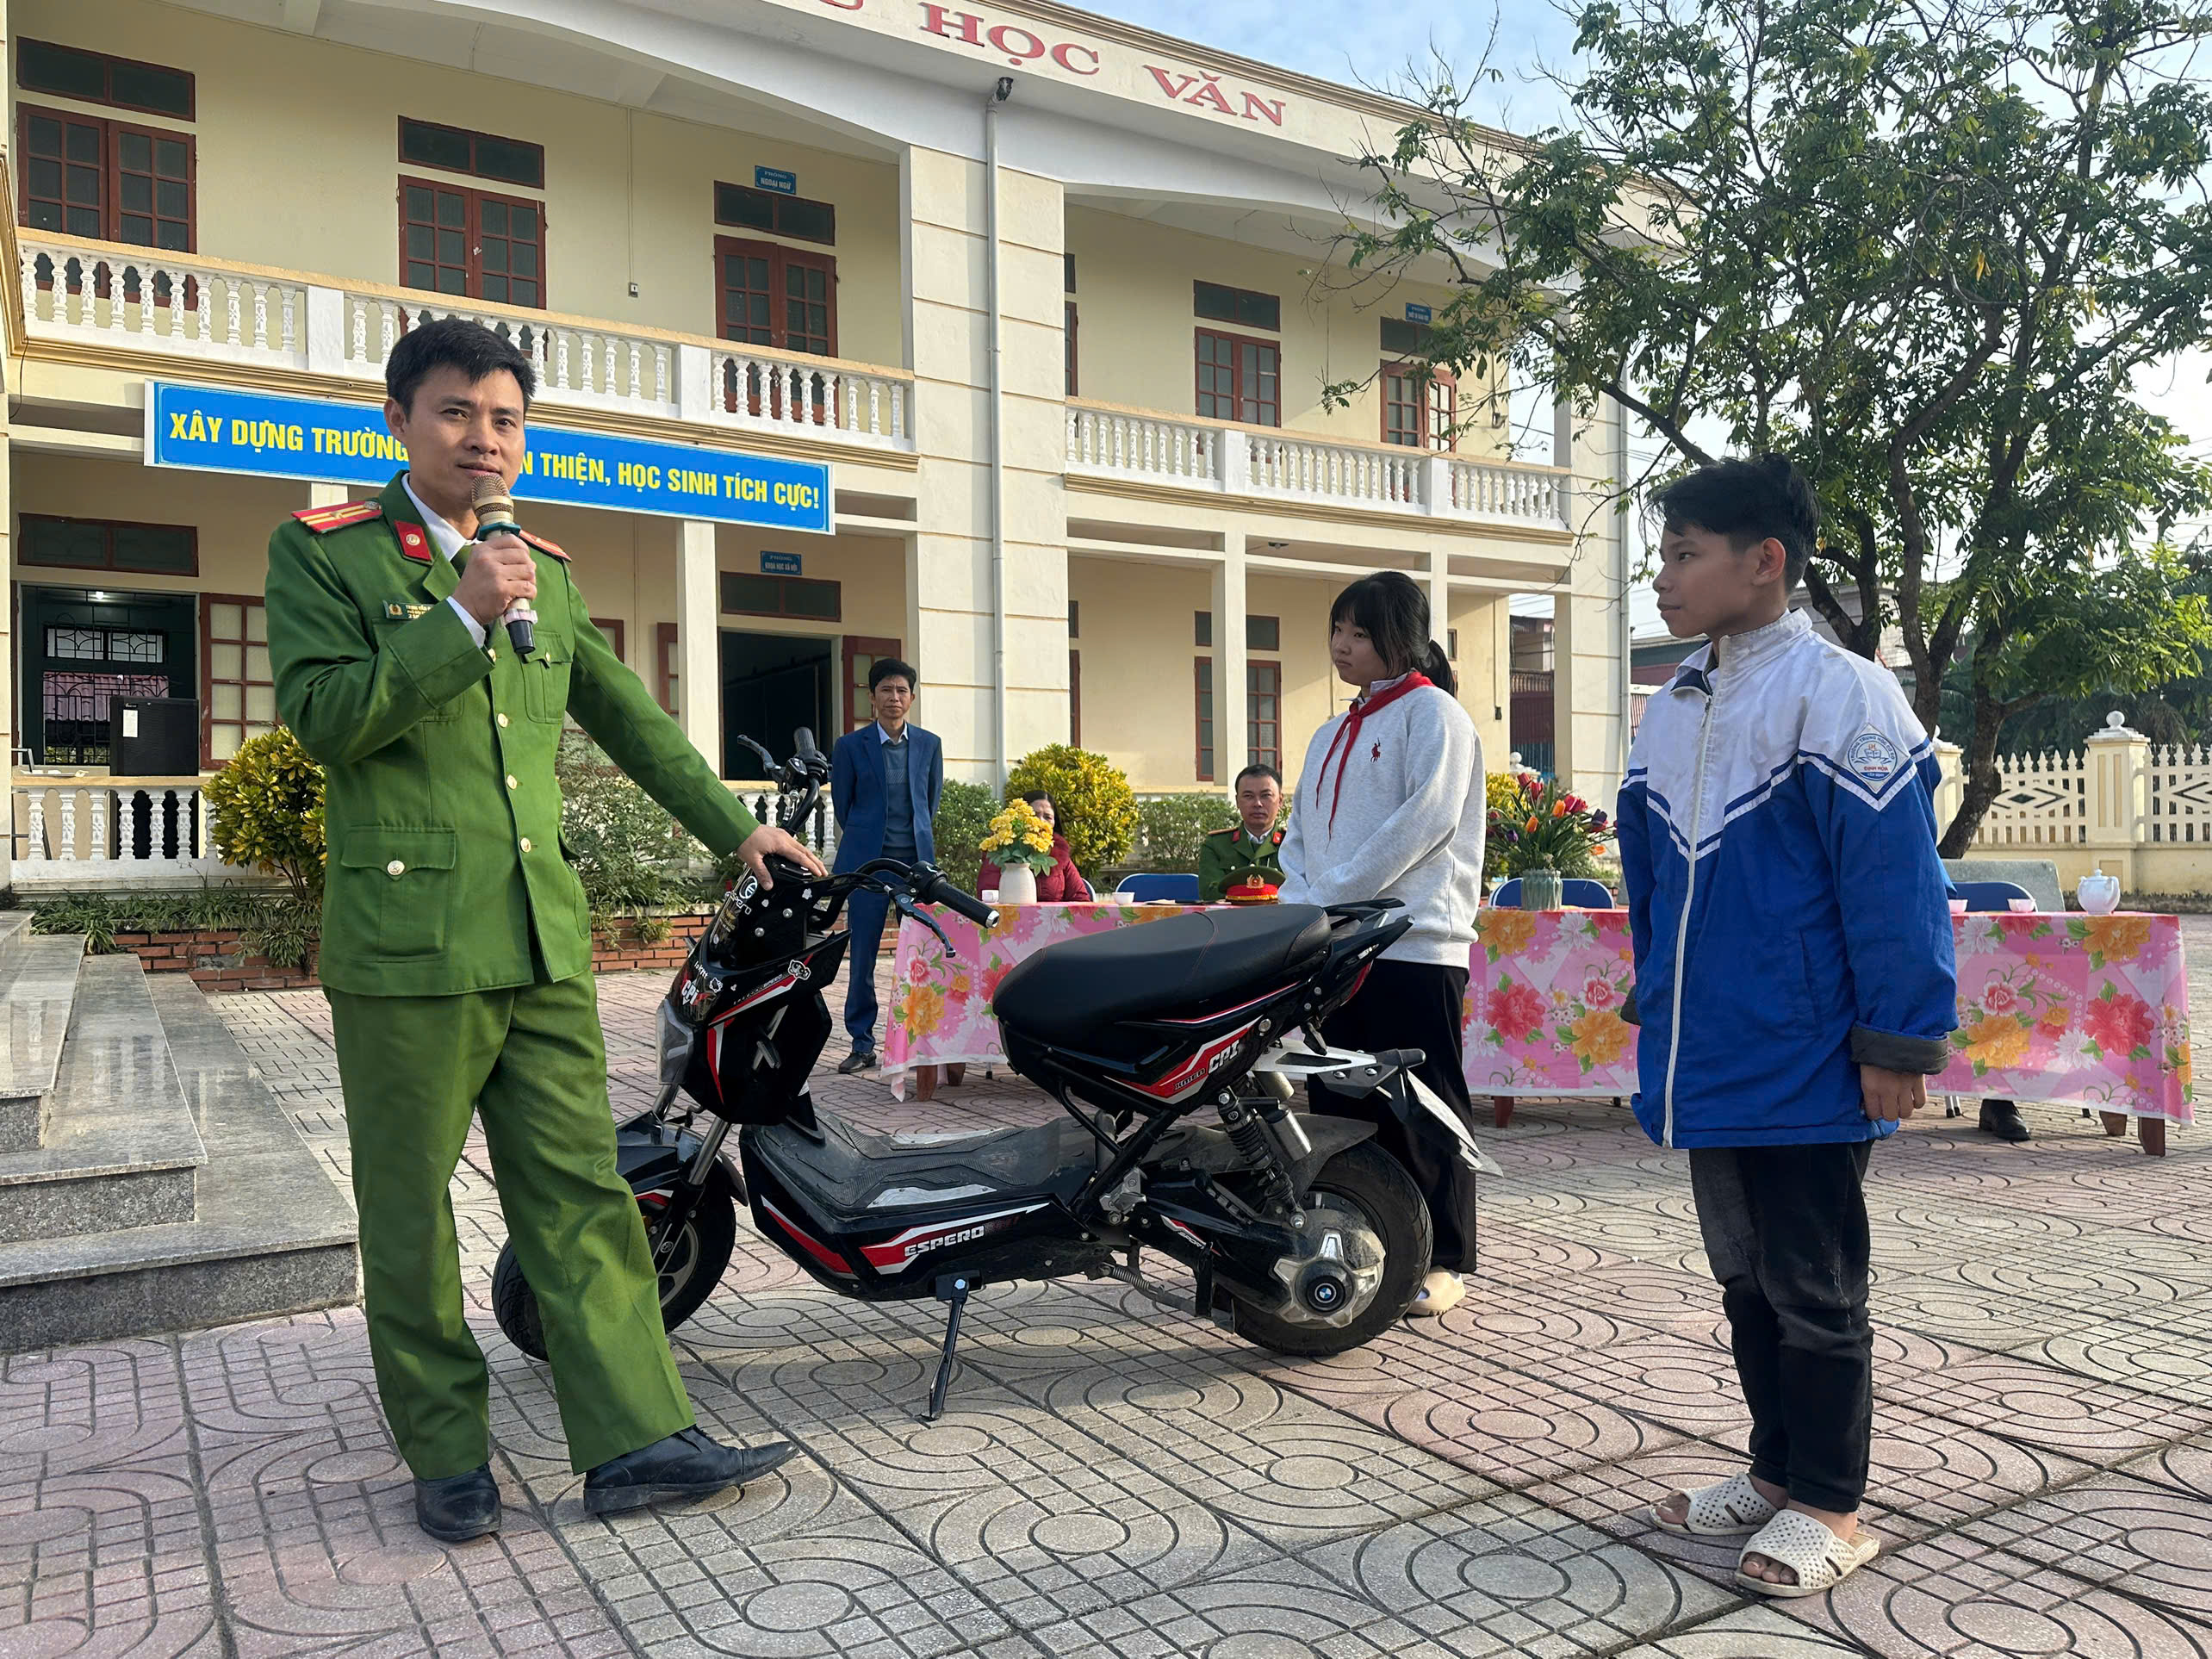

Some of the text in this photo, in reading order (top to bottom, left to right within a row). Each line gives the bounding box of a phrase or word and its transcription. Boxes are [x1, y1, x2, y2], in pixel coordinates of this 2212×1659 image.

[918, 2, 1286, 126] HỌC VĂN
[170, 409, 410, 463] XÂY DỰNG TRƯỜNG
[540, 451, 611, 487] THIỆN,
[618, 462, 661, 493] HỌC
[668, 467, 717, 497] SINH
[723, 471, 767, 503] TÍCH
[774, 481, 819, 511] CỰC!
[904, 1224, 985, 1258] ESPERO
